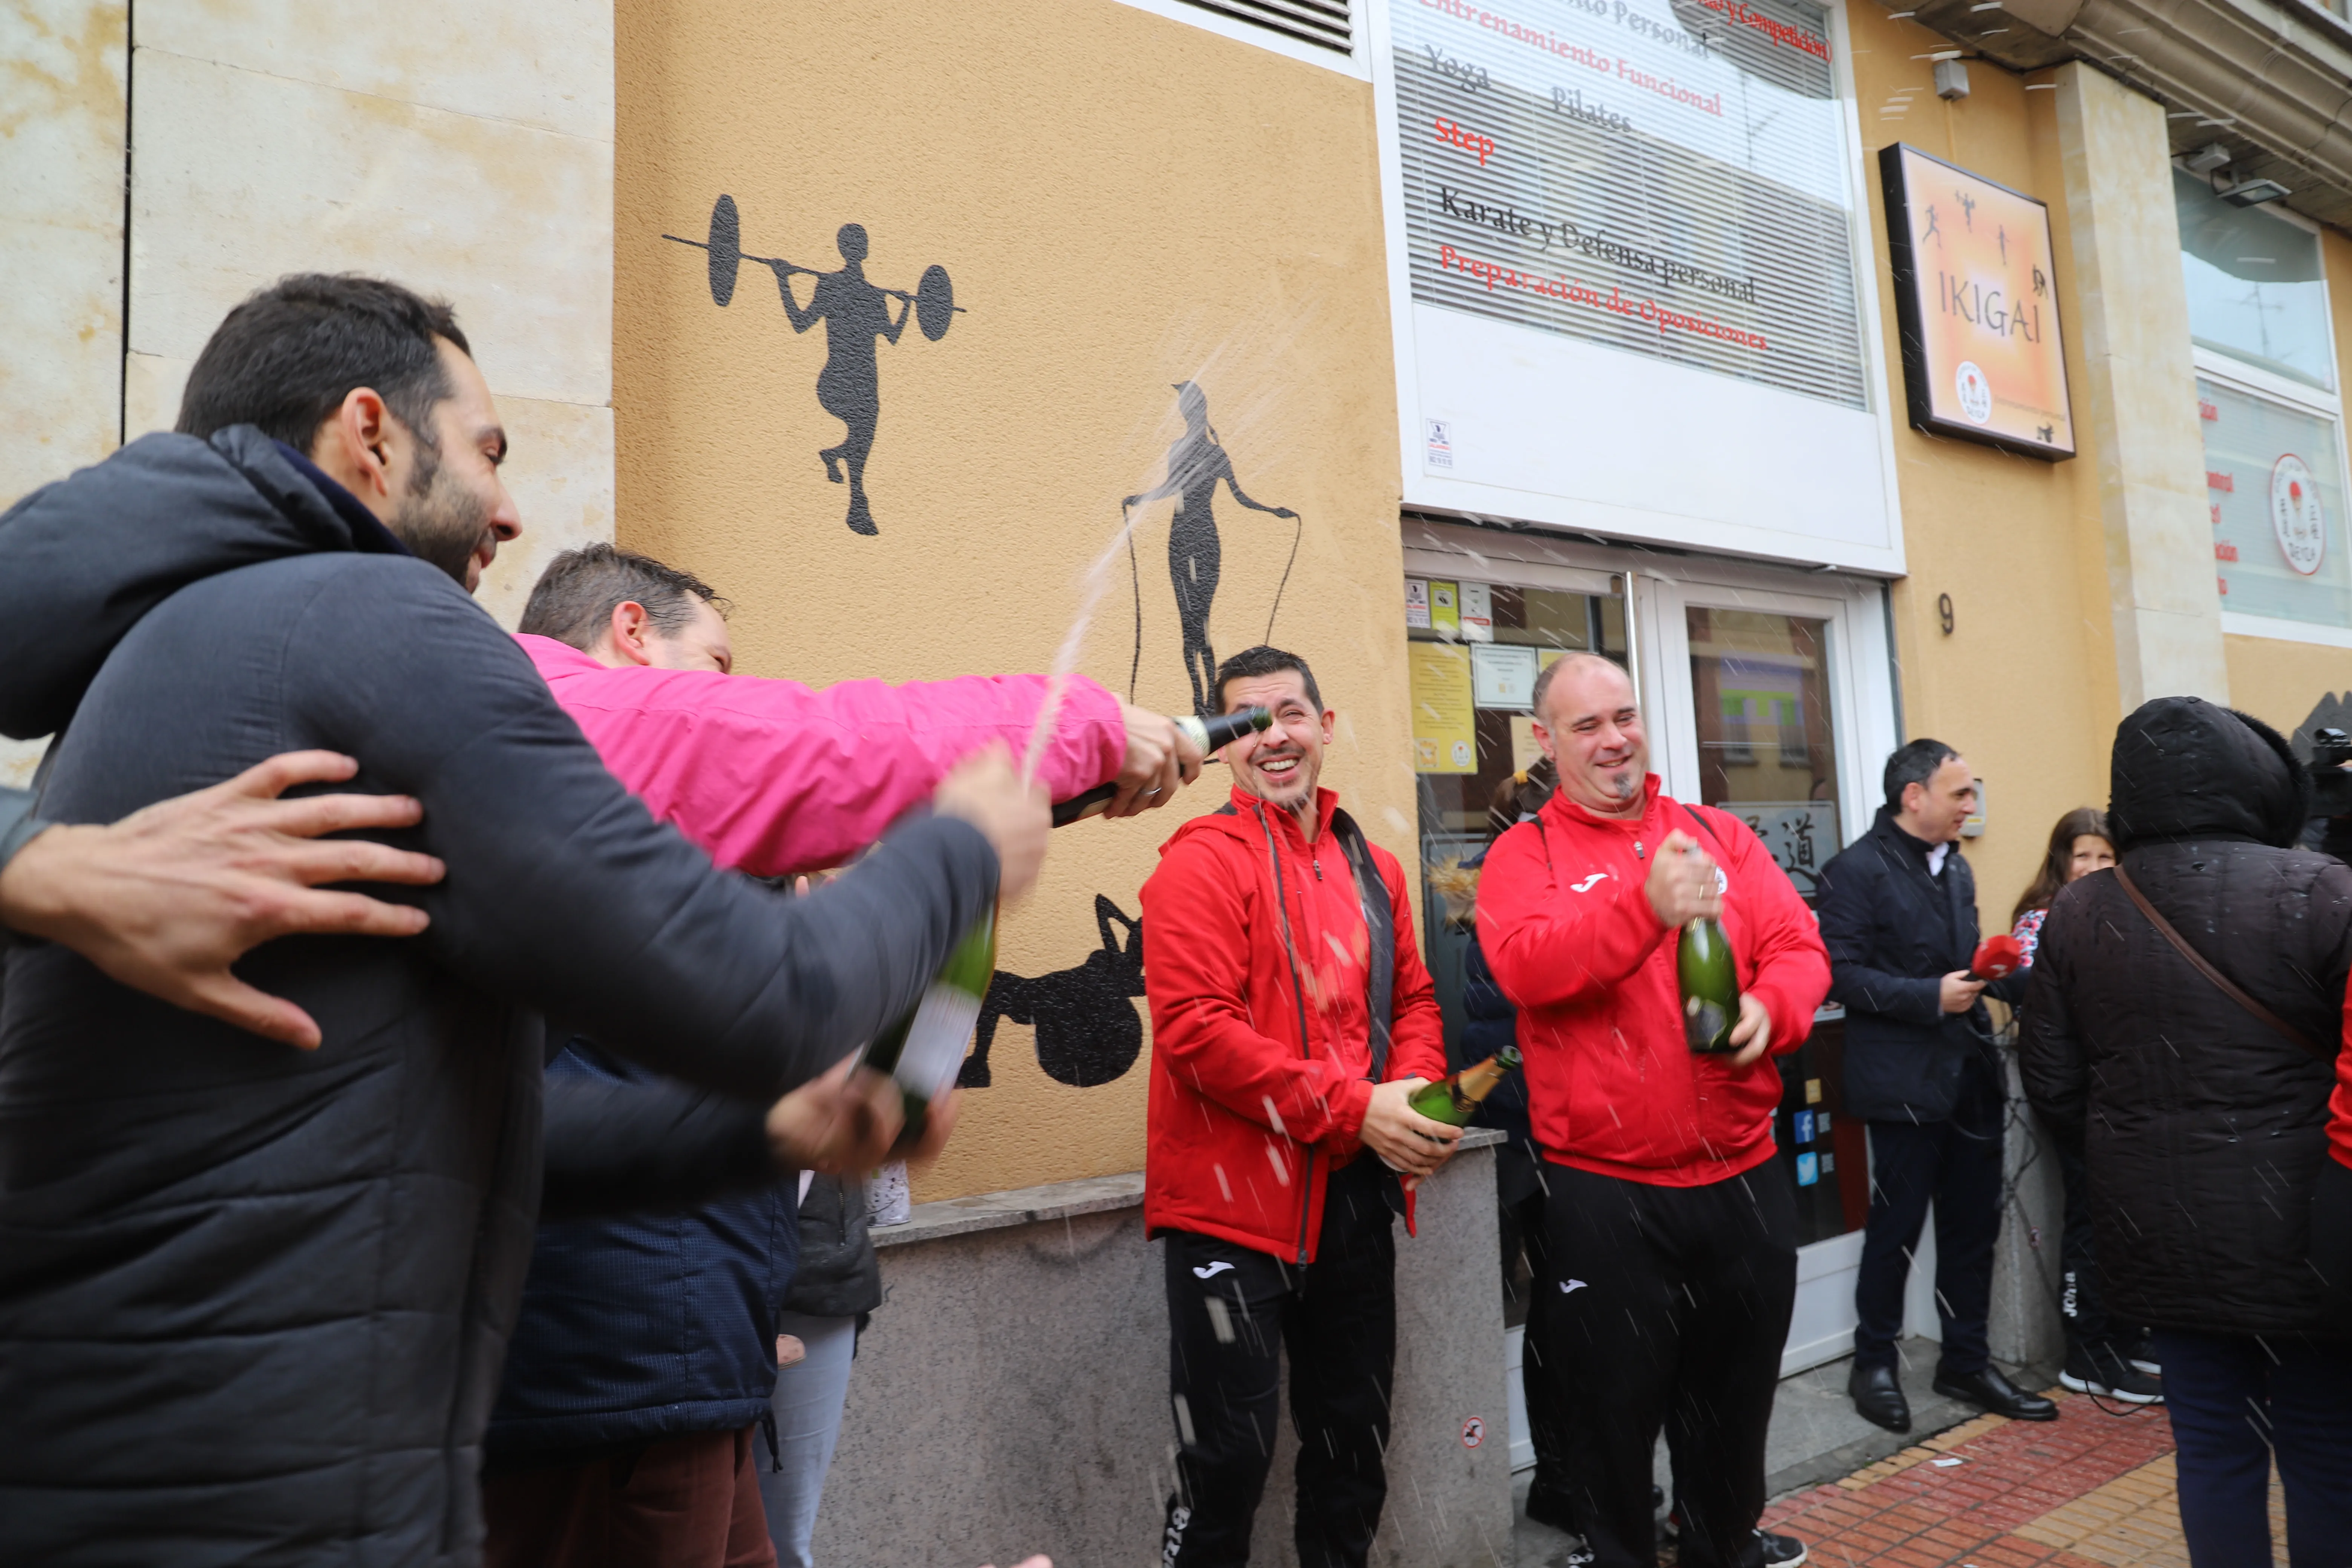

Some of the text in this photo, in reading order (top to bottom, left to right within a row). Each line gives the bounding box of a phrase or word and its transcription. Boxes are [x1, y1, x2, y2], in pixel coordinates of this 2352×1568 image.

[1613, 0, 1710, 60] Personal
[1739, 3, 1833, 64] Competición)
[1425, 44, 1491, 94] Yoga
[1617, 58, 1724, 117] Funcional
[1551, 86, 1632, 133] Pilates
[1434, 117, 1494, 166] Step
[1442, 187, 1757, 303] Karate y Defensa personal
[1439, 245, 1768, 350] Preparación de Oposiciones
[1939, 270, 2040, 343] IKIGAI
[1939, 593, 1954, 634] 9
